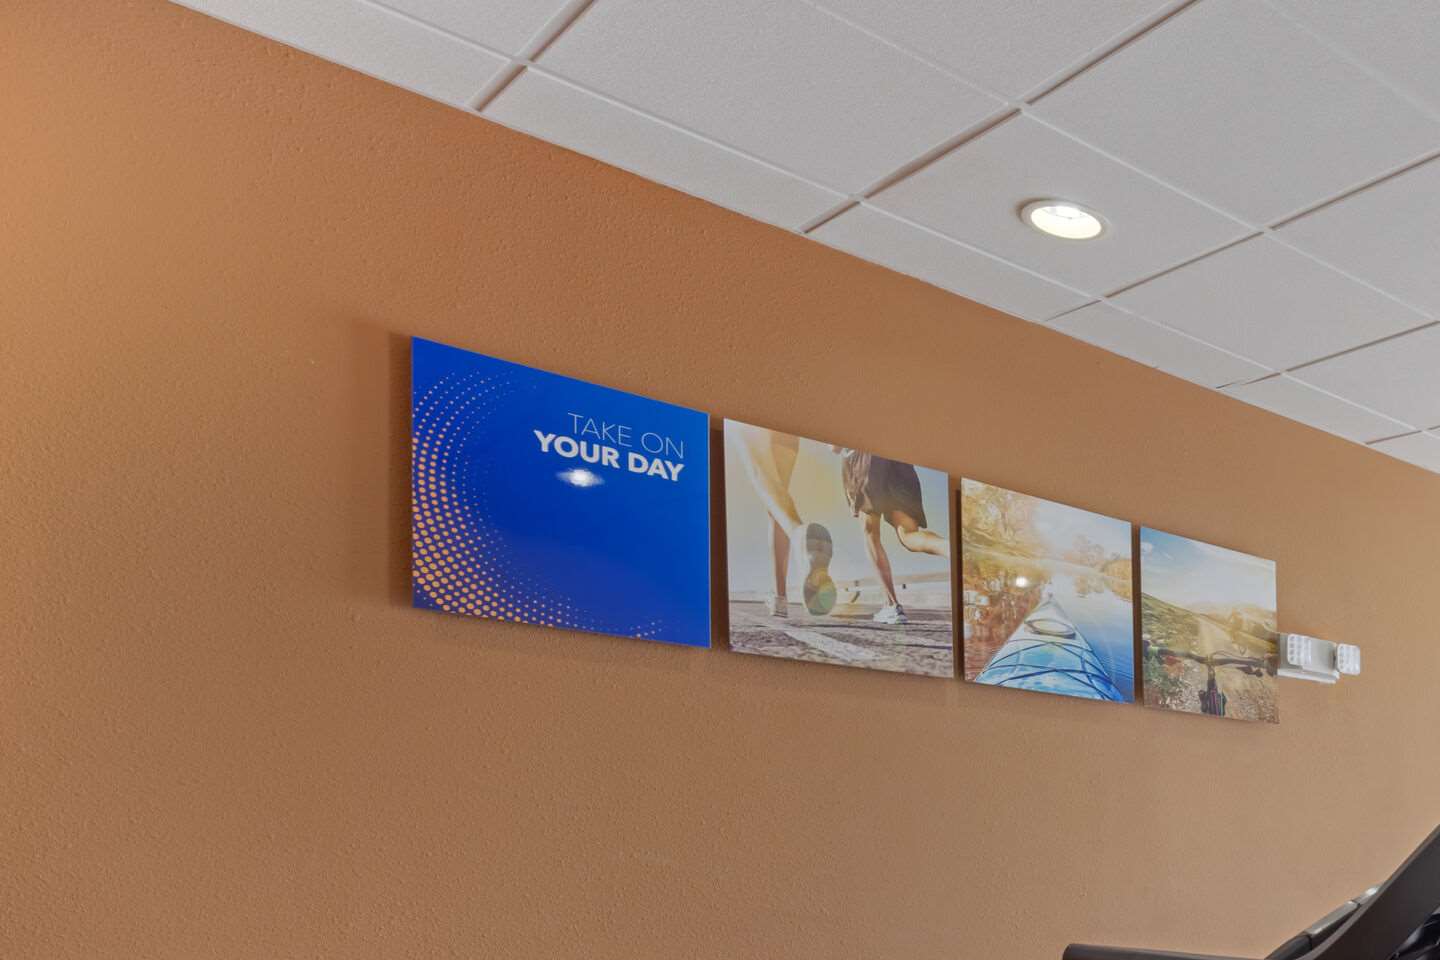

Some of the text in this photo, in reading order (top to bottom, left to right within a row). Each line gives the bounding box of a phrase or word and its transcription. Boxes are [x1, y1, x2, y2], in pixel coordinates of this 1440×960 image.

[533, 429, 685, 482] YOUR DAY
[567, 412, 684, 459] TAKE ON
